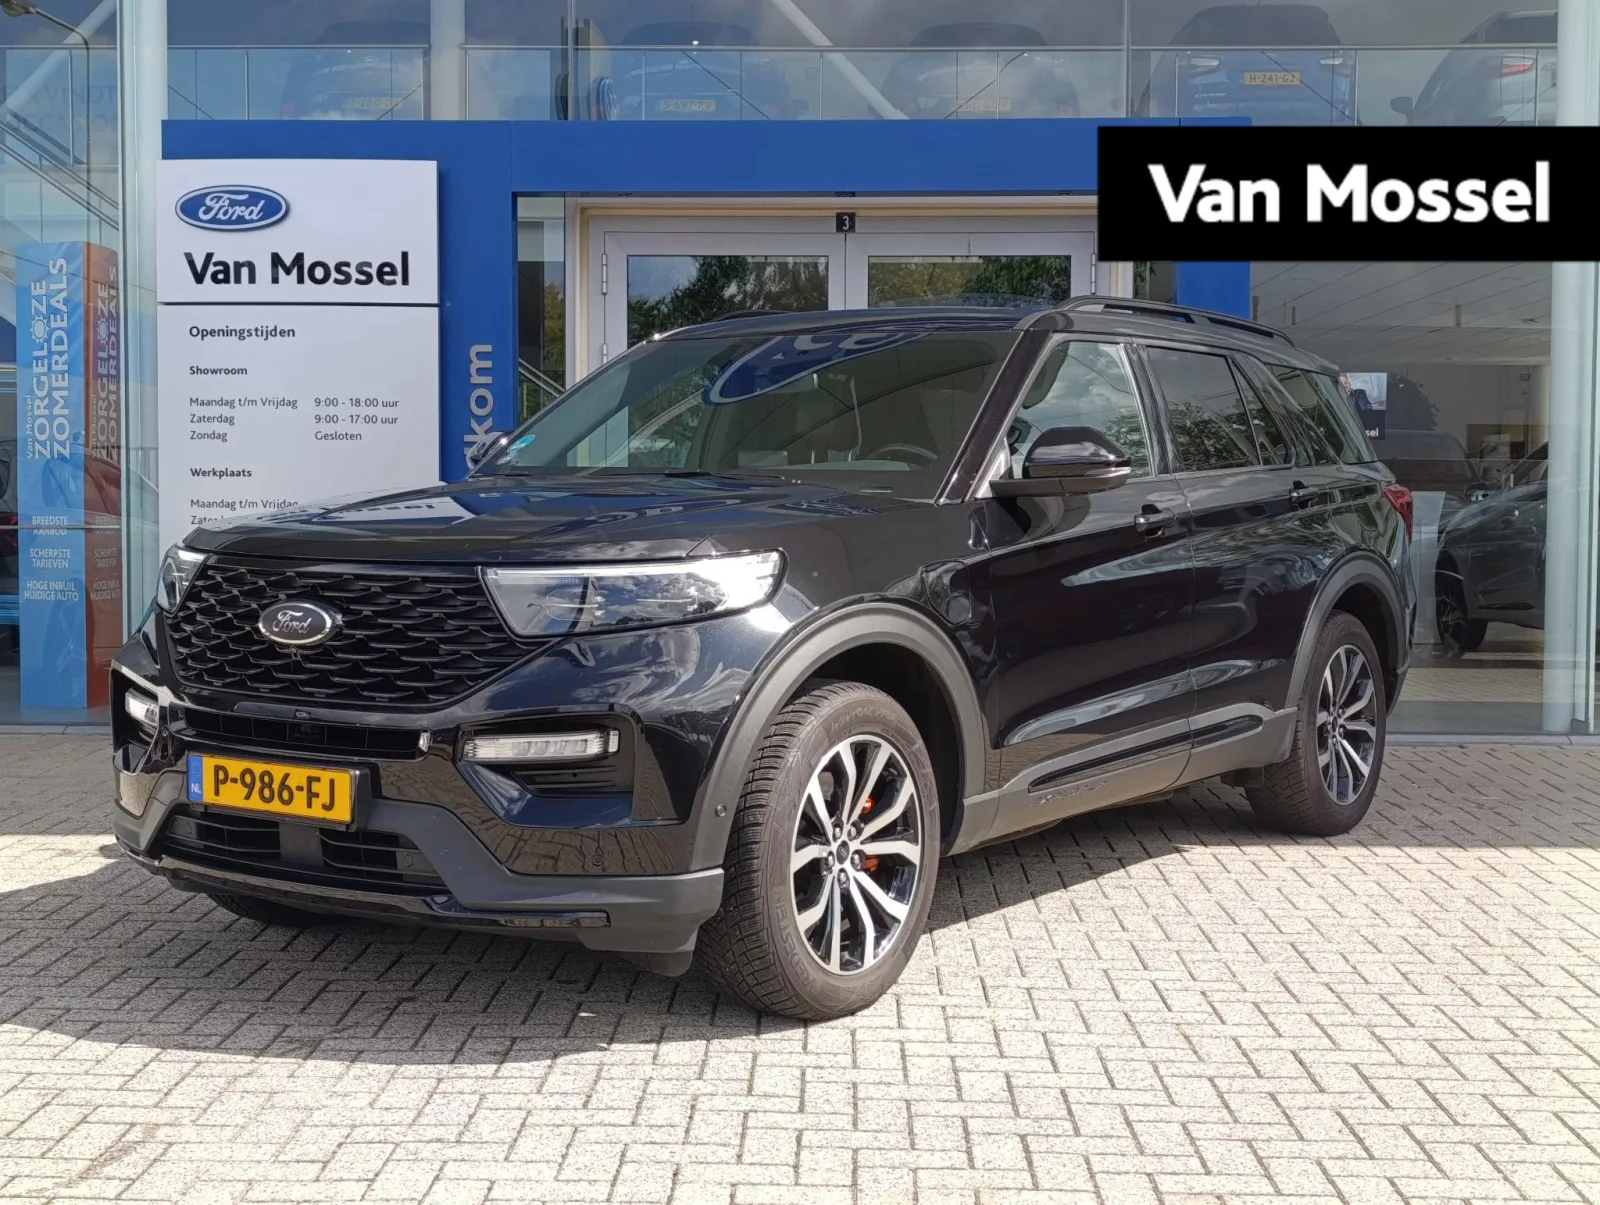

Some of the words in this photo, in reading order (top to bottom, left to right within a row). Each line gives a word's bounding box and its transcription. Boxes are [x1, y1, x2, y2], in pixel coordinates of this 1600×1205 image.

[198, 193, 265, 221] Ford
[842, 215, 850, 230] 3
[183, 251, 257, 285] Van
[270, 250, 410, 286] Mossel
[188, 325, 296, 341] Openingstijden
[48, 258, 70, 459] ZOMERDEALS
[188, 365, 248, 376] Showroom
[189, 397, 236, 409] Maandag
[238, 397, 258, 407] t/m
[260, 397, 298, 410] Vrijdag
[314, 398, 338, 408] 9:00
[349, 398, 379, 408] 18:00
[381, 400, 400, 408] uur
[463, 344, 494, 455] kom
[25, 394, 33, 434] Mossel
[189, 413, 235, 426] Zaterdag
[314, 414, 339, 424] 9:00
[349, 414, 378, 425] 17:00
[381, 417, 399, 425] uur
[189, 430, 228, 442] Zondag
[314, 430, 362, 441] Gesloten
[190, 467, 252, 479] Werkplaats
[190, 499, 237, 511] Maandag
[239, 499, 258, 509] t/m
[31, 516, 69, 526] BREEDSTE
[29, 548, 72, 558] SCHERPSTE
[32, 559, 69, 568] TARIEVEN
[26, 580, 49, 590] HOGE
[49, 581, 76, 591] INRUIL
[24, 590, 55, 600] HUIDIGE
[56, 591, 79, 601] AUTO
[272, 610, 312, 633] Ford
[191, 782, 203, 794] NL
[213, 764, 336, 812] P-986-FJ
